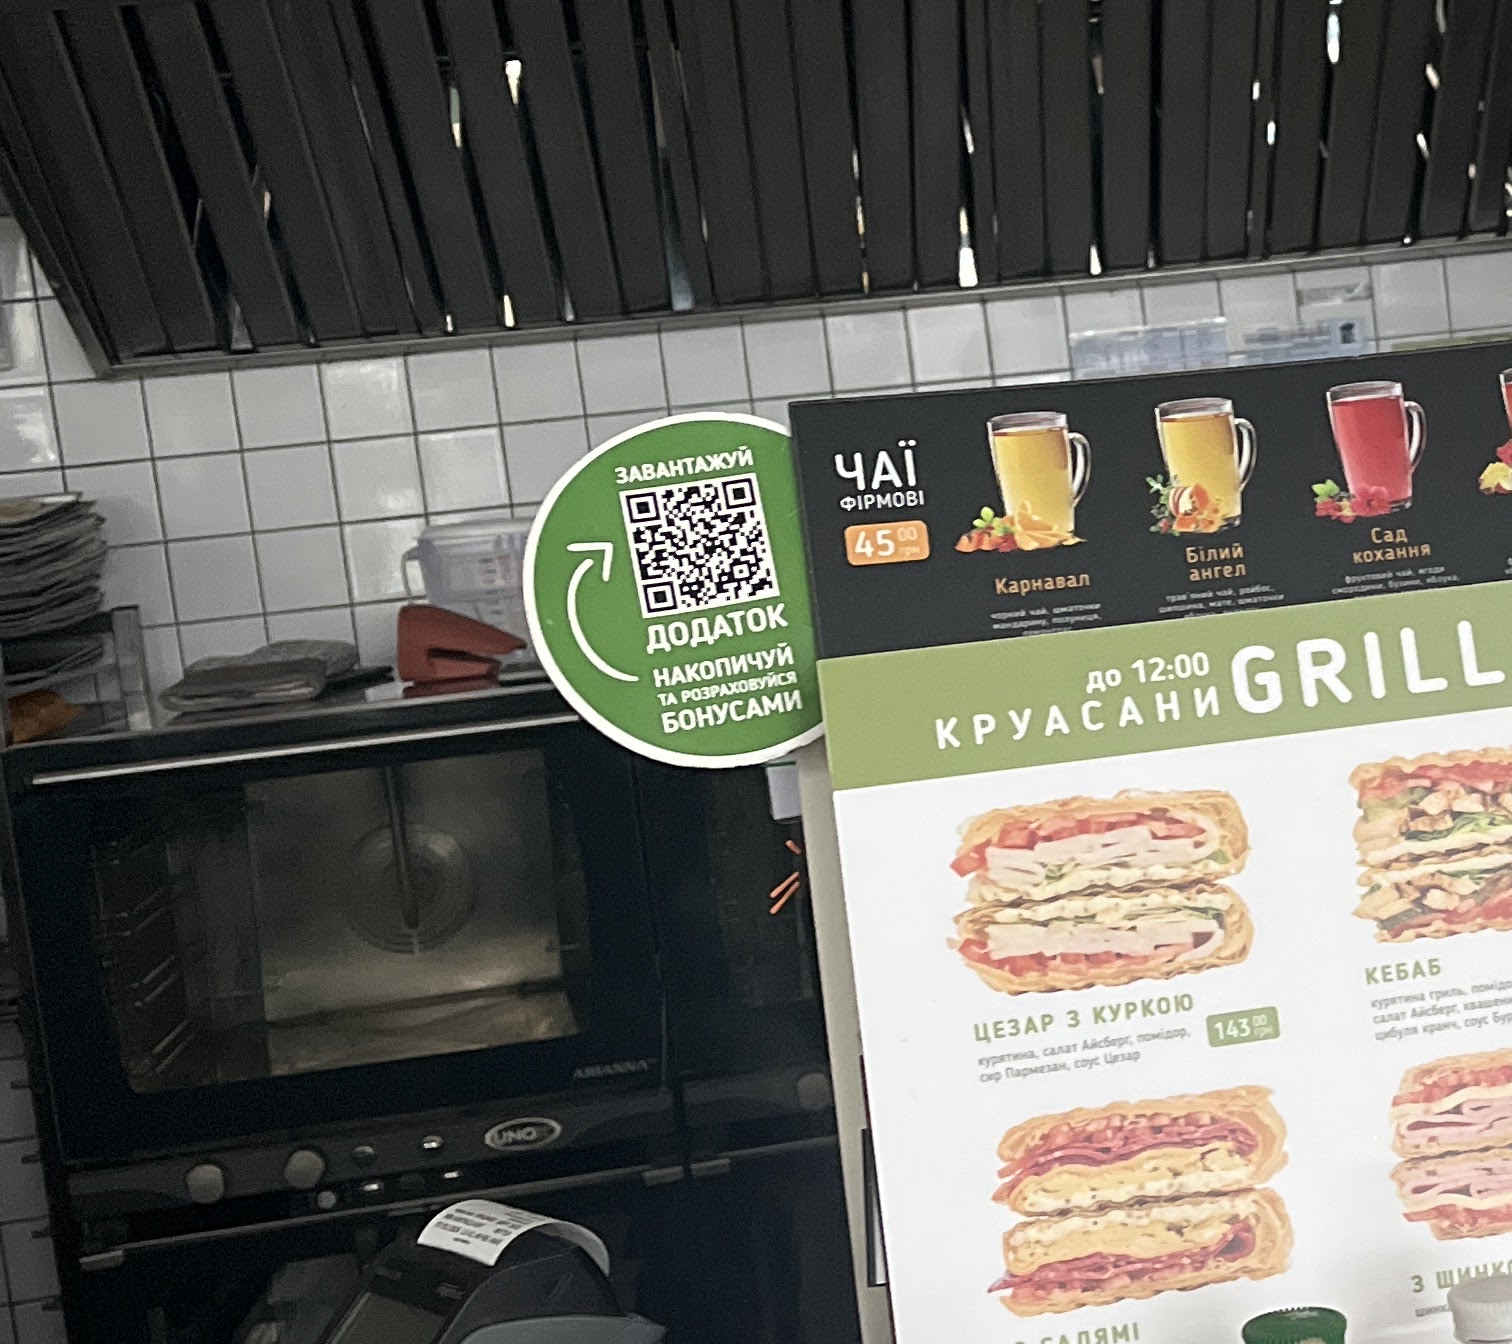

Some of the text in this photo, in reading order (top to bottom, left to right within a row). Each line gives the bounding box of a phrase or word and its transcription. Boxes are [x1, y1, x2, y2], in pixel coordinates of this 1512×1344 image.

[613, 444, 755, 486] ЗАВАНТАЖУЙ
[834, 439, 919, 493] ЧАЇ
[839, 487, 926, 514] ФІРМОВІ
[852, 527, 897, 562] 45
[1184, 542, 1246, 568] Білий
[1351, 541, 1433, 565] кохання
[1369, 525, 1408, 548] Сад
[994, 568, 1092, 598] Карнавал
[1188, 561, 1248, 587] ангел
[645, 601, 790, 656] ДОДАТОК
[652, 640, 796, 690] НАКОПИЧУЙ
[1085, 650, 1211, 696] до 12:00
[656, 668, 798, 708] ТА РОЗРАХОВУЙСЯ
[934, 619, 1506, 752] КРУАСАНИ GRILL
[659, 687, 804, 735] БОНУСАМИ
[1364, 957, 1442, 987] КЕБАБ
[973, 991, 1252, 1045] ЦЕЗАР З КУРКОЮ 143
[1410, 1273, 1426, 1294] З
